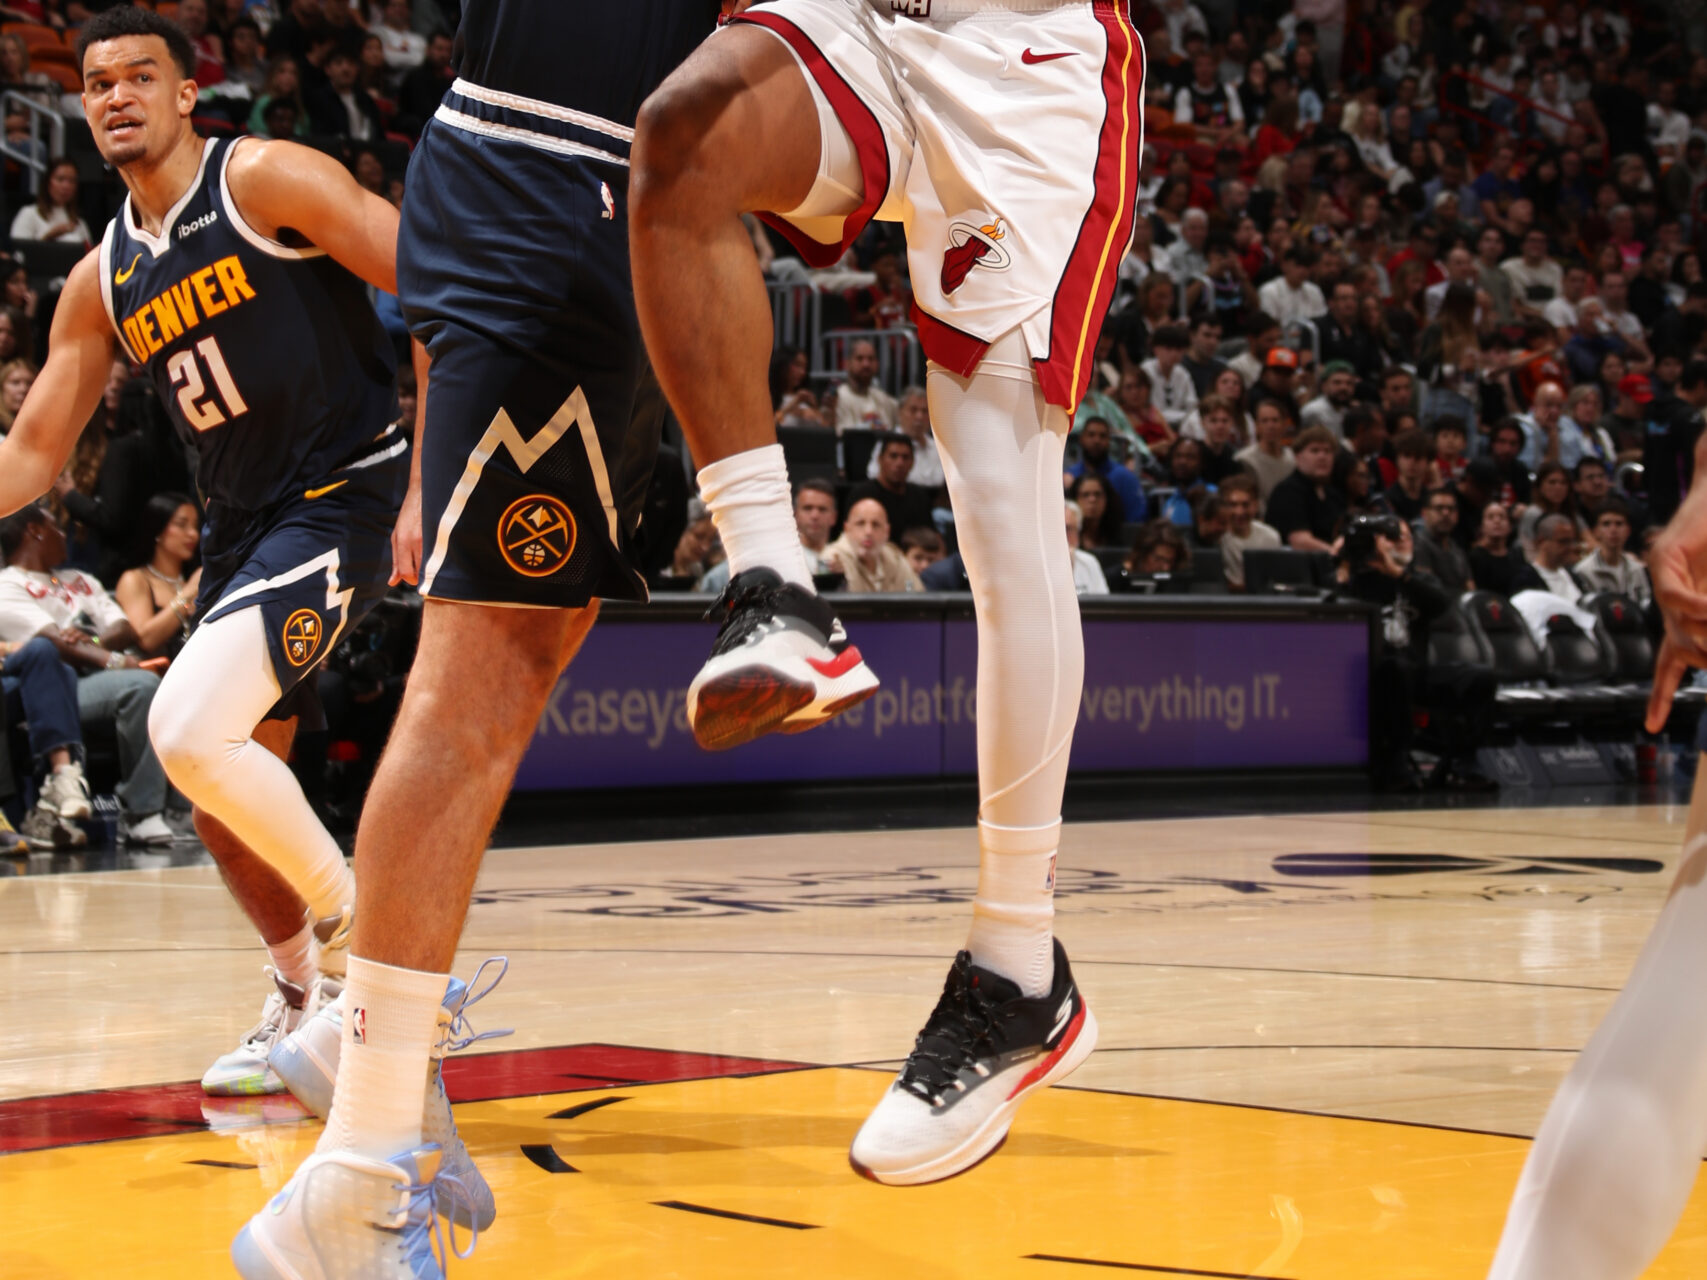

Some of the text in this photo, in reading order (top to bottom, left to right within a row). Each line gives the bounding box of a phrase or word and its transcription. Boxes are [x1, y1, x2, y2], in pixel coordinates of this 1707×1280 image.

[177, 210, 218, 239] ibotta
[122, 254, 257, 365] DENVER
[166, 334, 249, 432] 21
[1083, 673, 1246, 734] verything
[1253, 674, 1289, 719] IT.
